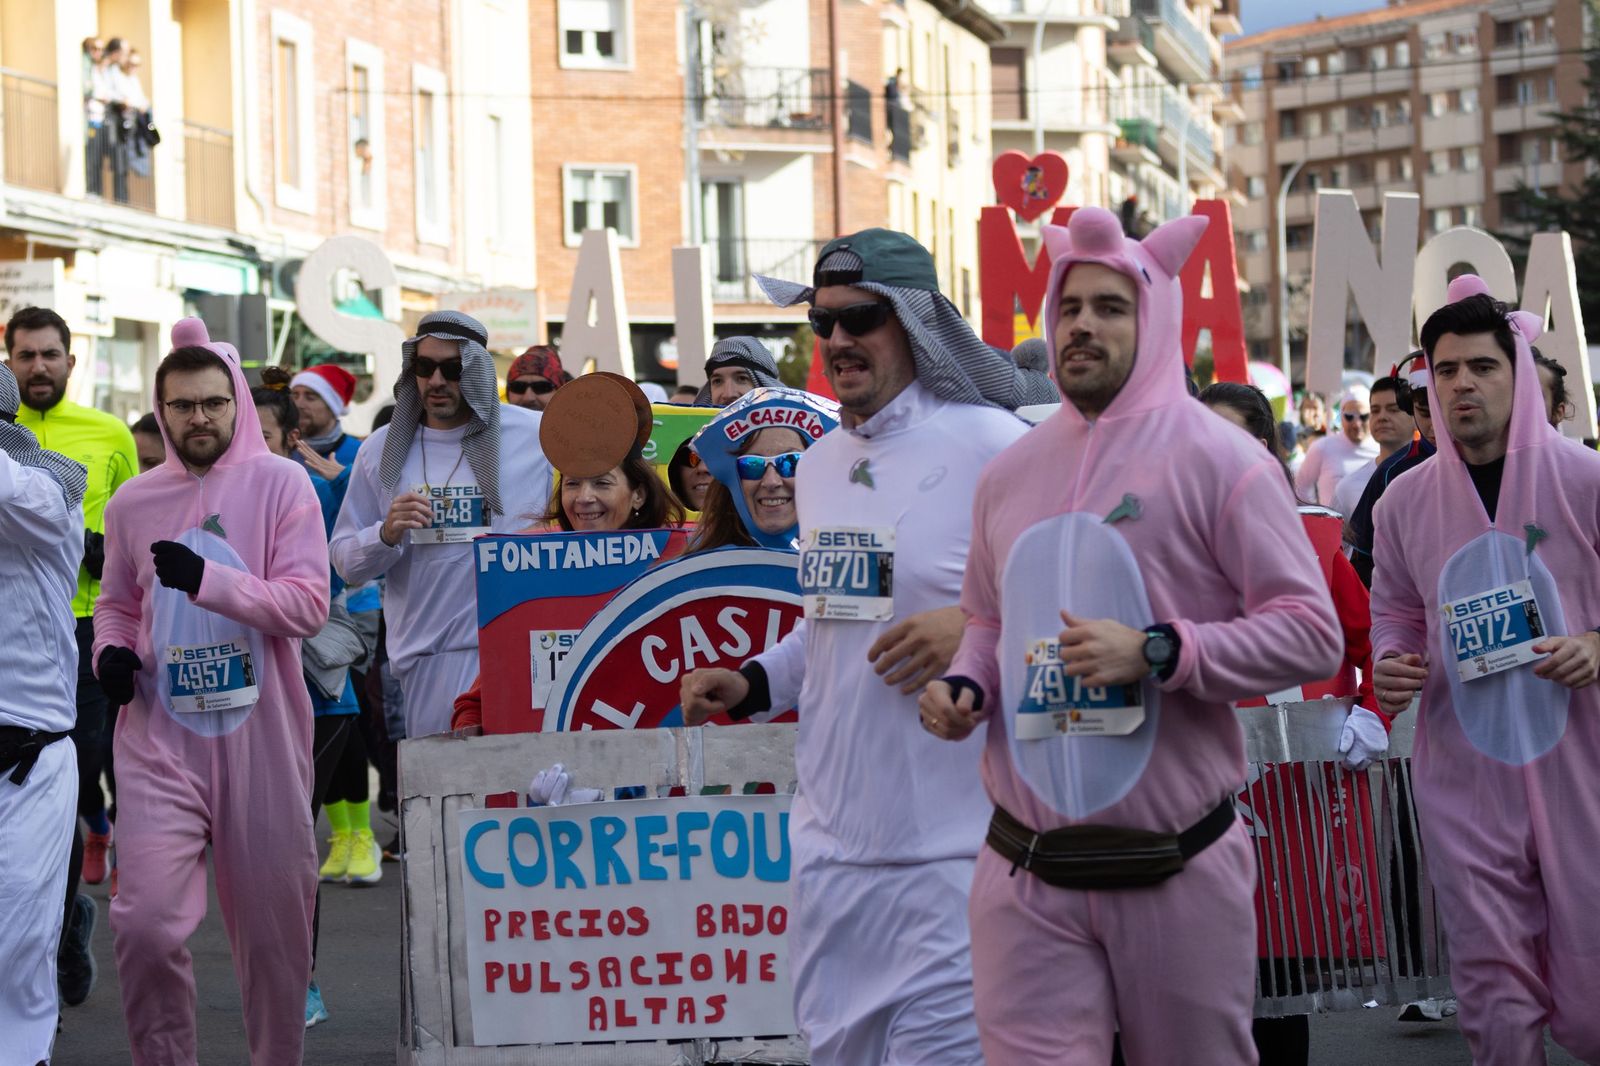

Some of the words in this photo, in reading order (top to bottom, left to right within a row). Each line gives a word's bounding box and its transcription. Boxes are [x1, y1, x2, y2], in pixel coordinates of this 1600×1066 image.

[725, 420, 749, 440] EL
[750, 408, 824, 439] CASIRÍO
[431, 487, 483, 497] SETEL
[432, 499, 472, 523] 648
[478, 533, 661, 573] FONTANEDA
[818, 532, 883, 547] SETEL
[804, 551, 869, 589] 3670
[1454, 589, 1522, 617] SETEL
[1449, 608, 1517, 655] 2972
[183, 643, 241, 660] SETEL
[177, 659, 230, 690] 4957
[484, 906, 650, 942] PRECIOS
[696, 903, 788, 938] BAJO
[588, 994, 728, 1031] ALTAS
